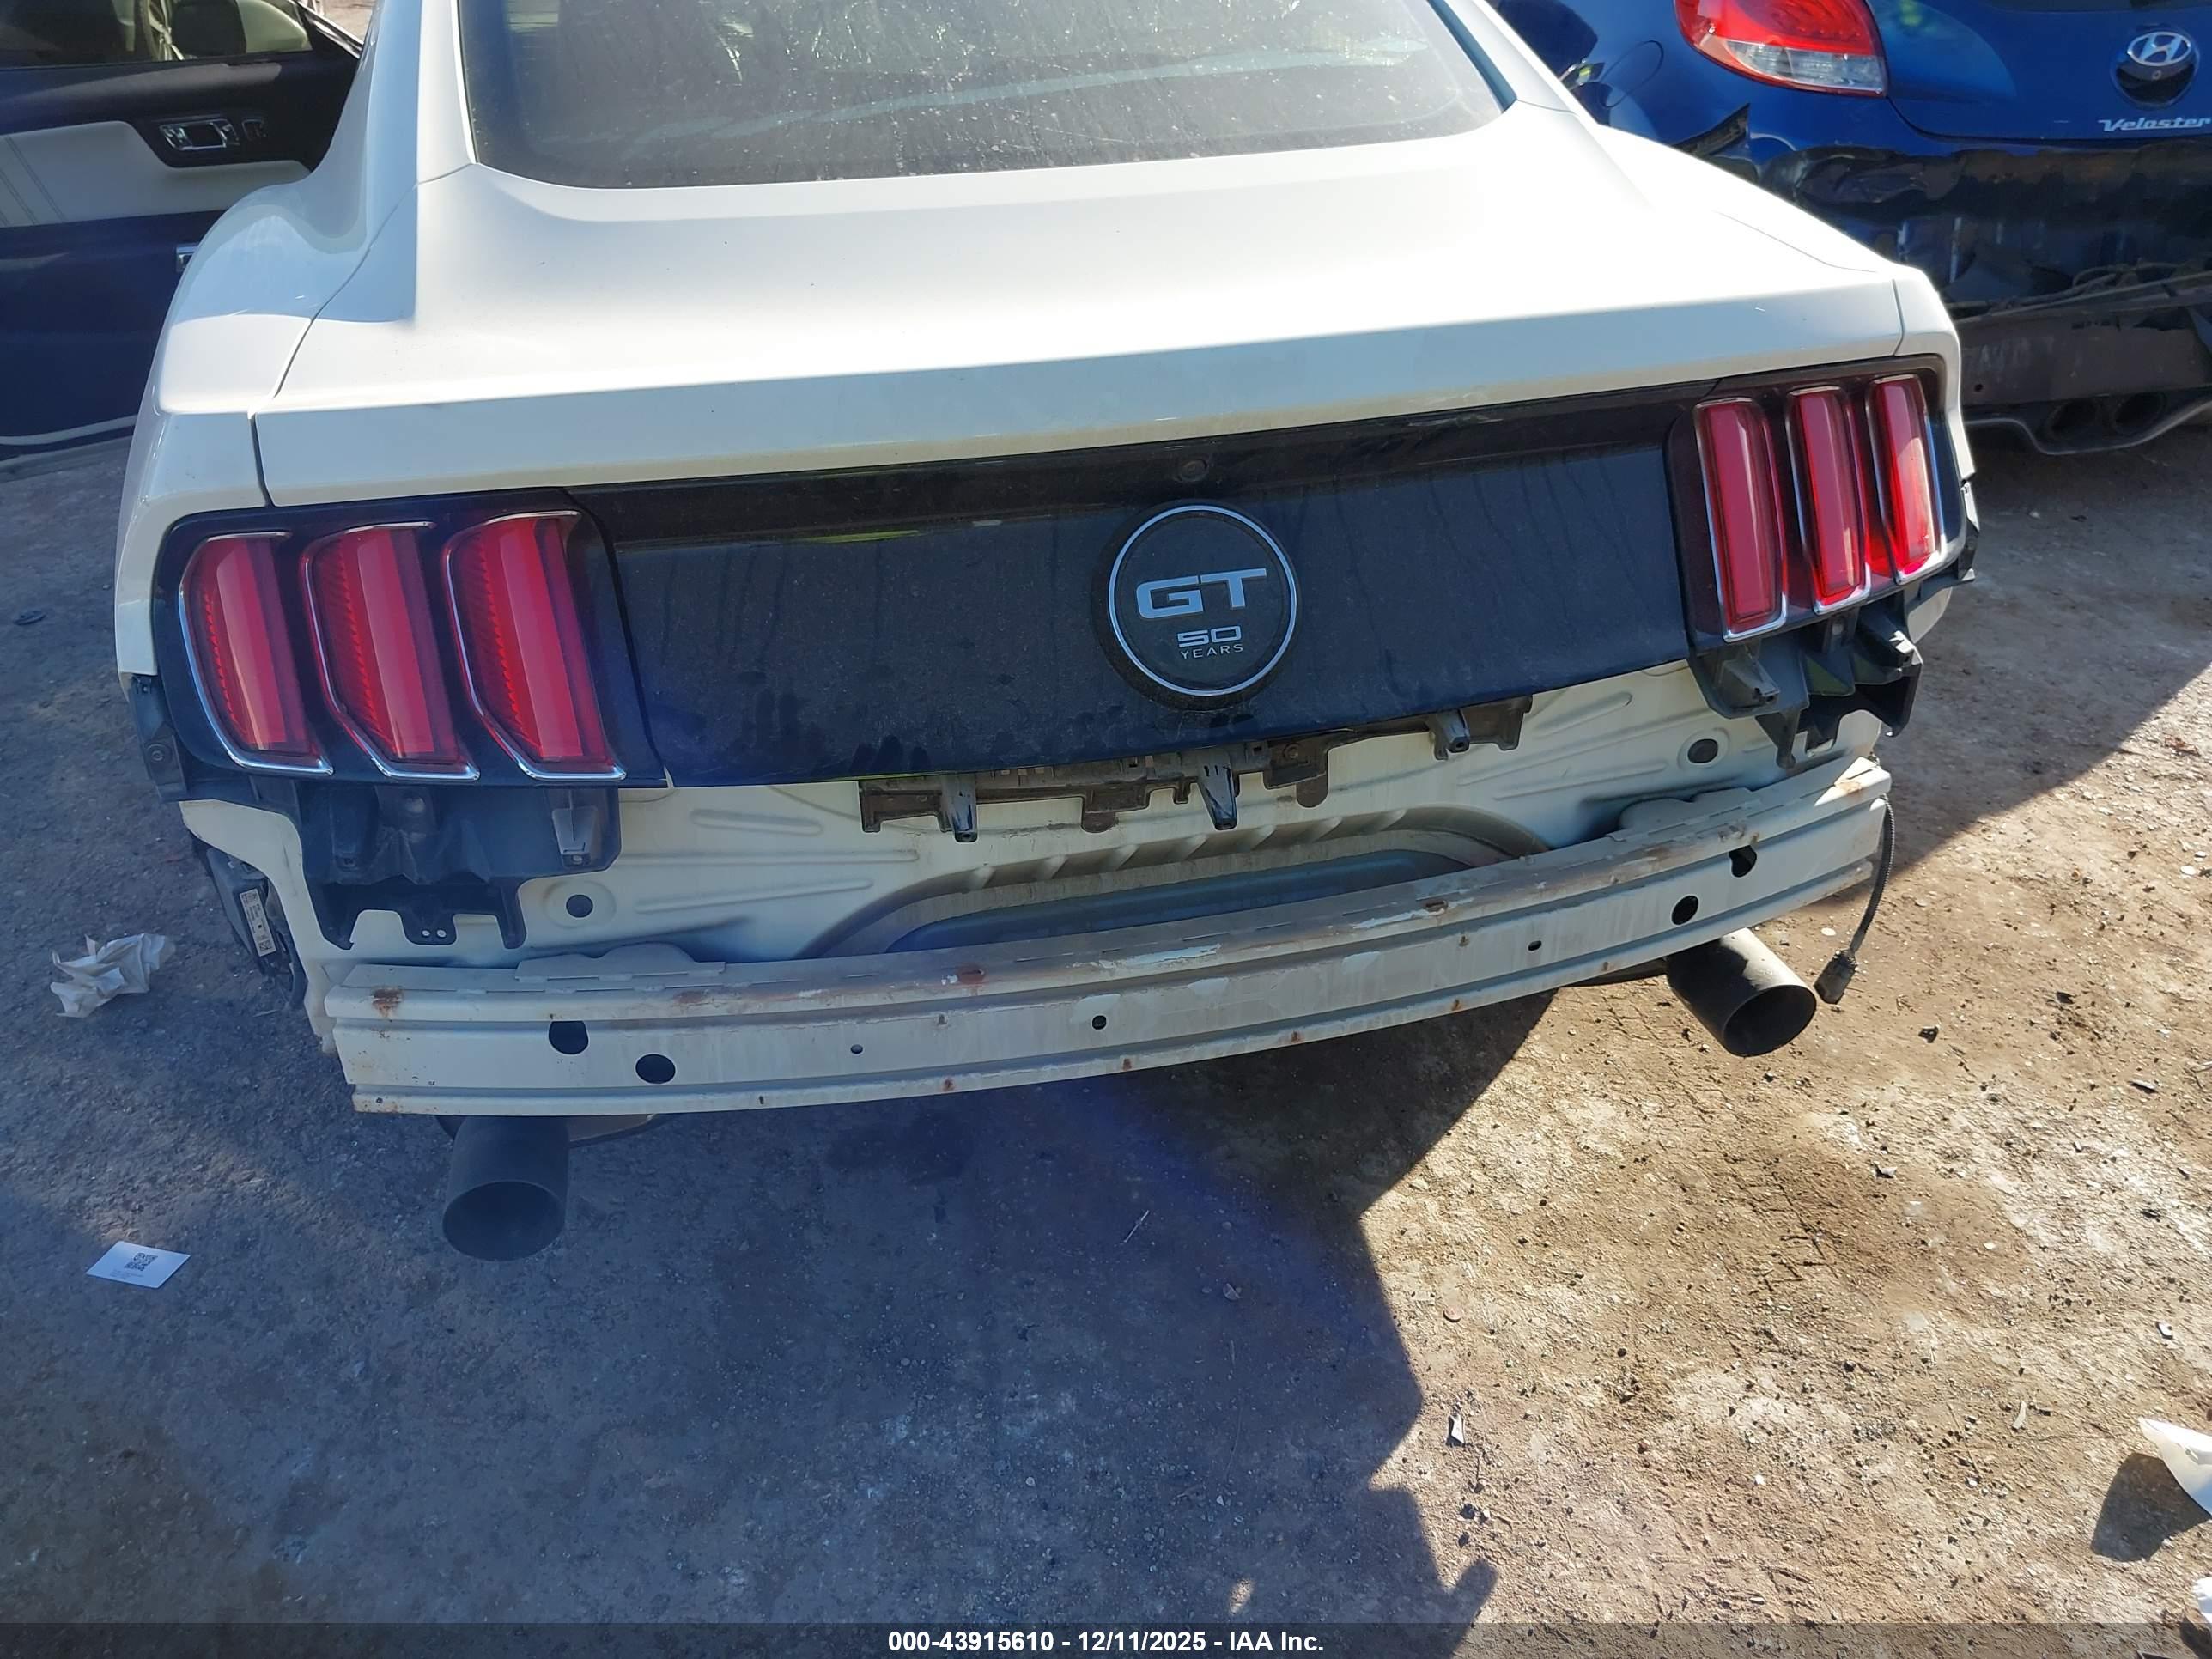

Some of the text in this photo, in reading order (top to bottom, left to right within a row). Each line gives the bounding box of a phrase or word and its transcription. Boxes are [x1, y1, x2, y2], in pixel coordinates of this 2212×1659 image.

[2097, 117, 2212, 131] Veloster
[1136, 568, 1267, 619] GT
[1177, 625, 1242, 647] 50
[1181, 644, 1243, 659] YEARS
